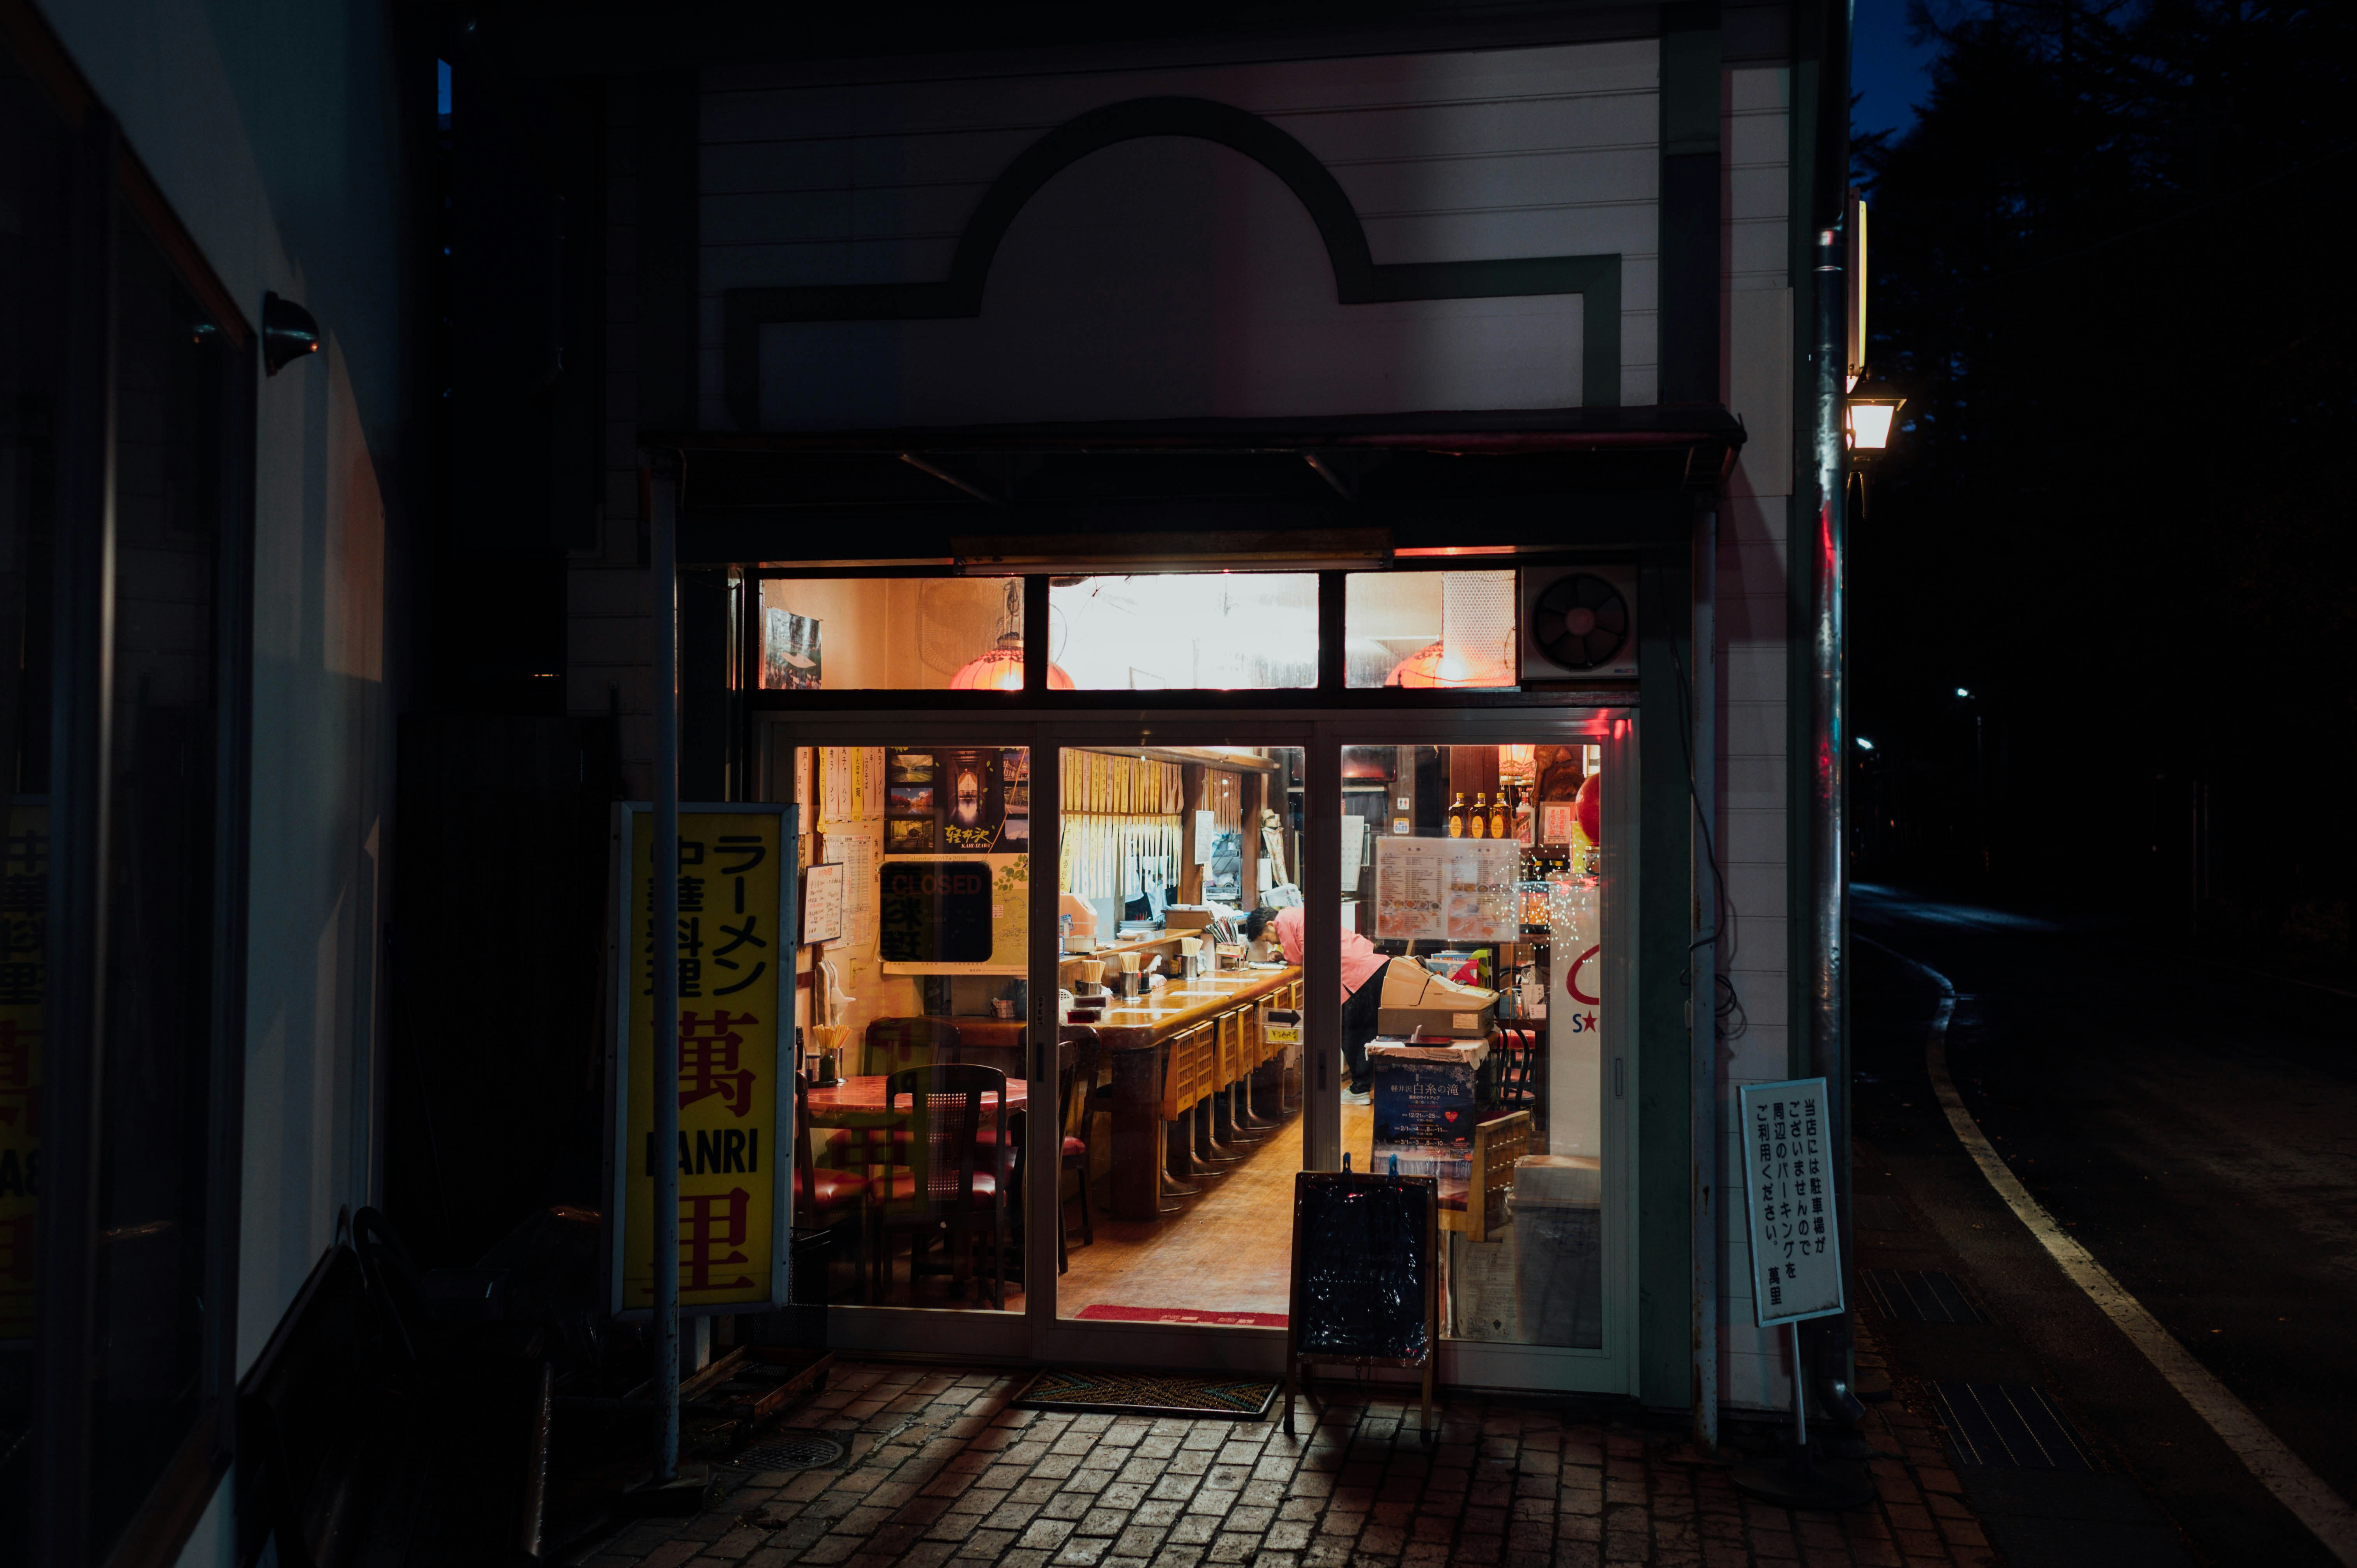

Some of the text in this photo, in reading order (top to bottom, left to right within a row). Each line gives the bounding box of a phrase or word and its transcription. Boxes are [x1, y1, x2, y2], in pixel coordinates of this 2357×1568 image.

[892, 874, 981, 895] CLOSED
[944, 824, 993, 845] 軽井沢
[713, 836, 767, 996] ラーメン
[1773, 1102, 1796, 1278] 周辺のパーキングを
[1789, 1101, 1810, 1256] ございませんので
[1804, 1098, 1825, 1254] 当店には駐車場が
